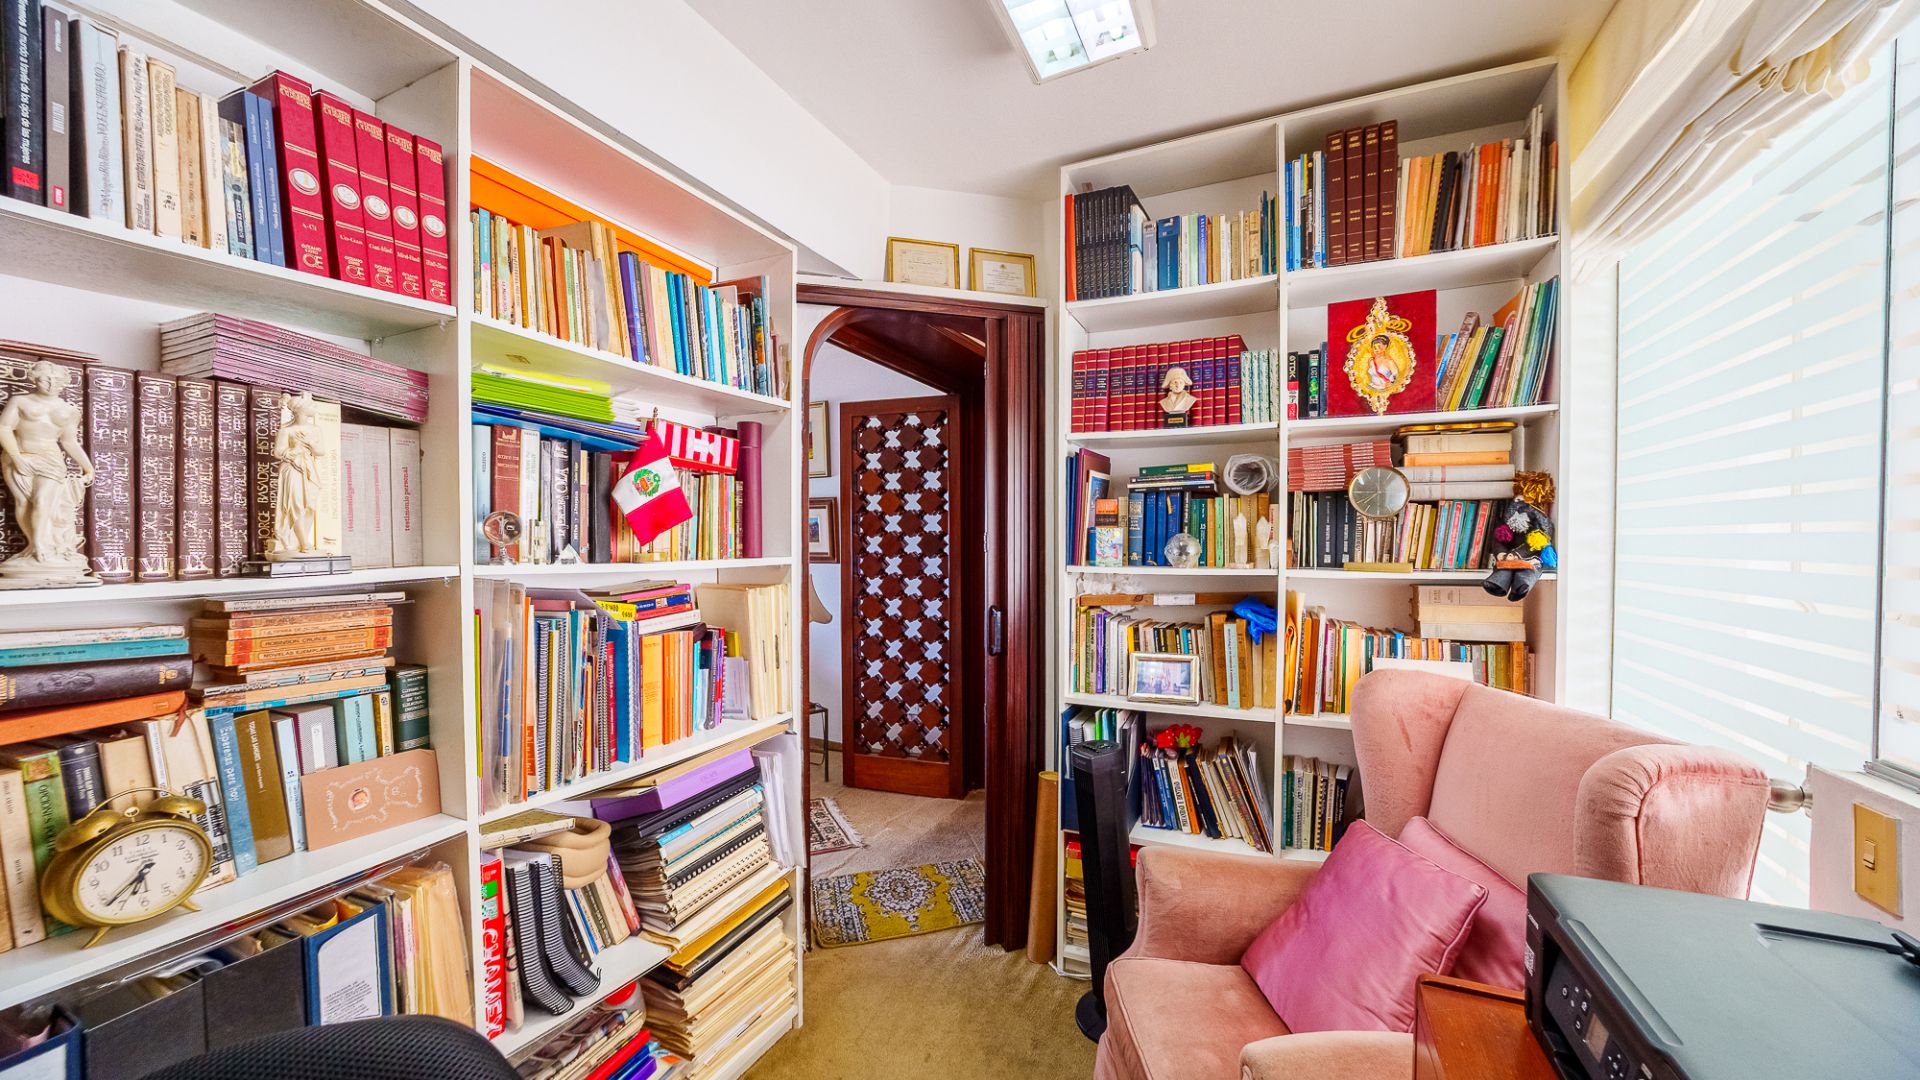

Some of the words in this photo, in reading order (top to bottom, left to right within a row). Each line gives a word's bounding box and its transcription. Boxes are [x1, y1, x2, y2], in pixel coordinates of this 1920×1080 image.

[18, 26, 29, 35] al
[19, 34, 30, 57] mundo
[19, 62, 31, 83] través
[21, 83, 31, 93] de
[21, 93, 31, 103] los
[19, 103, 32, 118] ojos
[22, 118, 32, 127] de
[22, 127, 32, 137] las
[21, 137, 32, 164] mujeres
[1288, 361, 1297, 378] TDK
[258, 411, 269, 455] HISTORIA
[258, 462, 269, 503] BASADRE
[401, 466, 411, 495] personal
[554, 468, 569, 493] OLA
[402, 495, 410, 531] testimonio
[258, 510, 269, 539] JORGE
[265, 639, 300, 648] ROBINSON
[263, 651, 294, 659] NOVELAS
[295, 646, 335, 656] EJEMPLARES
[248, 720, 256, 735] TODAS
[251, 743, 261, 762] SANGRES
[223, 767, 235, 786] para
[228, 786, 241, 802] hoy
[38, 784, 54, 824] OPCIONES
[135, 834, 150, 847] 12
[161, 833, 167, 844] 1
[176, 840, 186, 850] 2
[111, 845, 123, 857] 11
[184, 850, 193, 863] 3
[94, 860, 110, 873] 10
[177, 866, 186, 879] 4
[88, 876, 100, 890] 9
[118, 899, 128, 911] 7
[138, 896, 151, 907] 6
[482, 927, 504, 1039] CHAMEX
